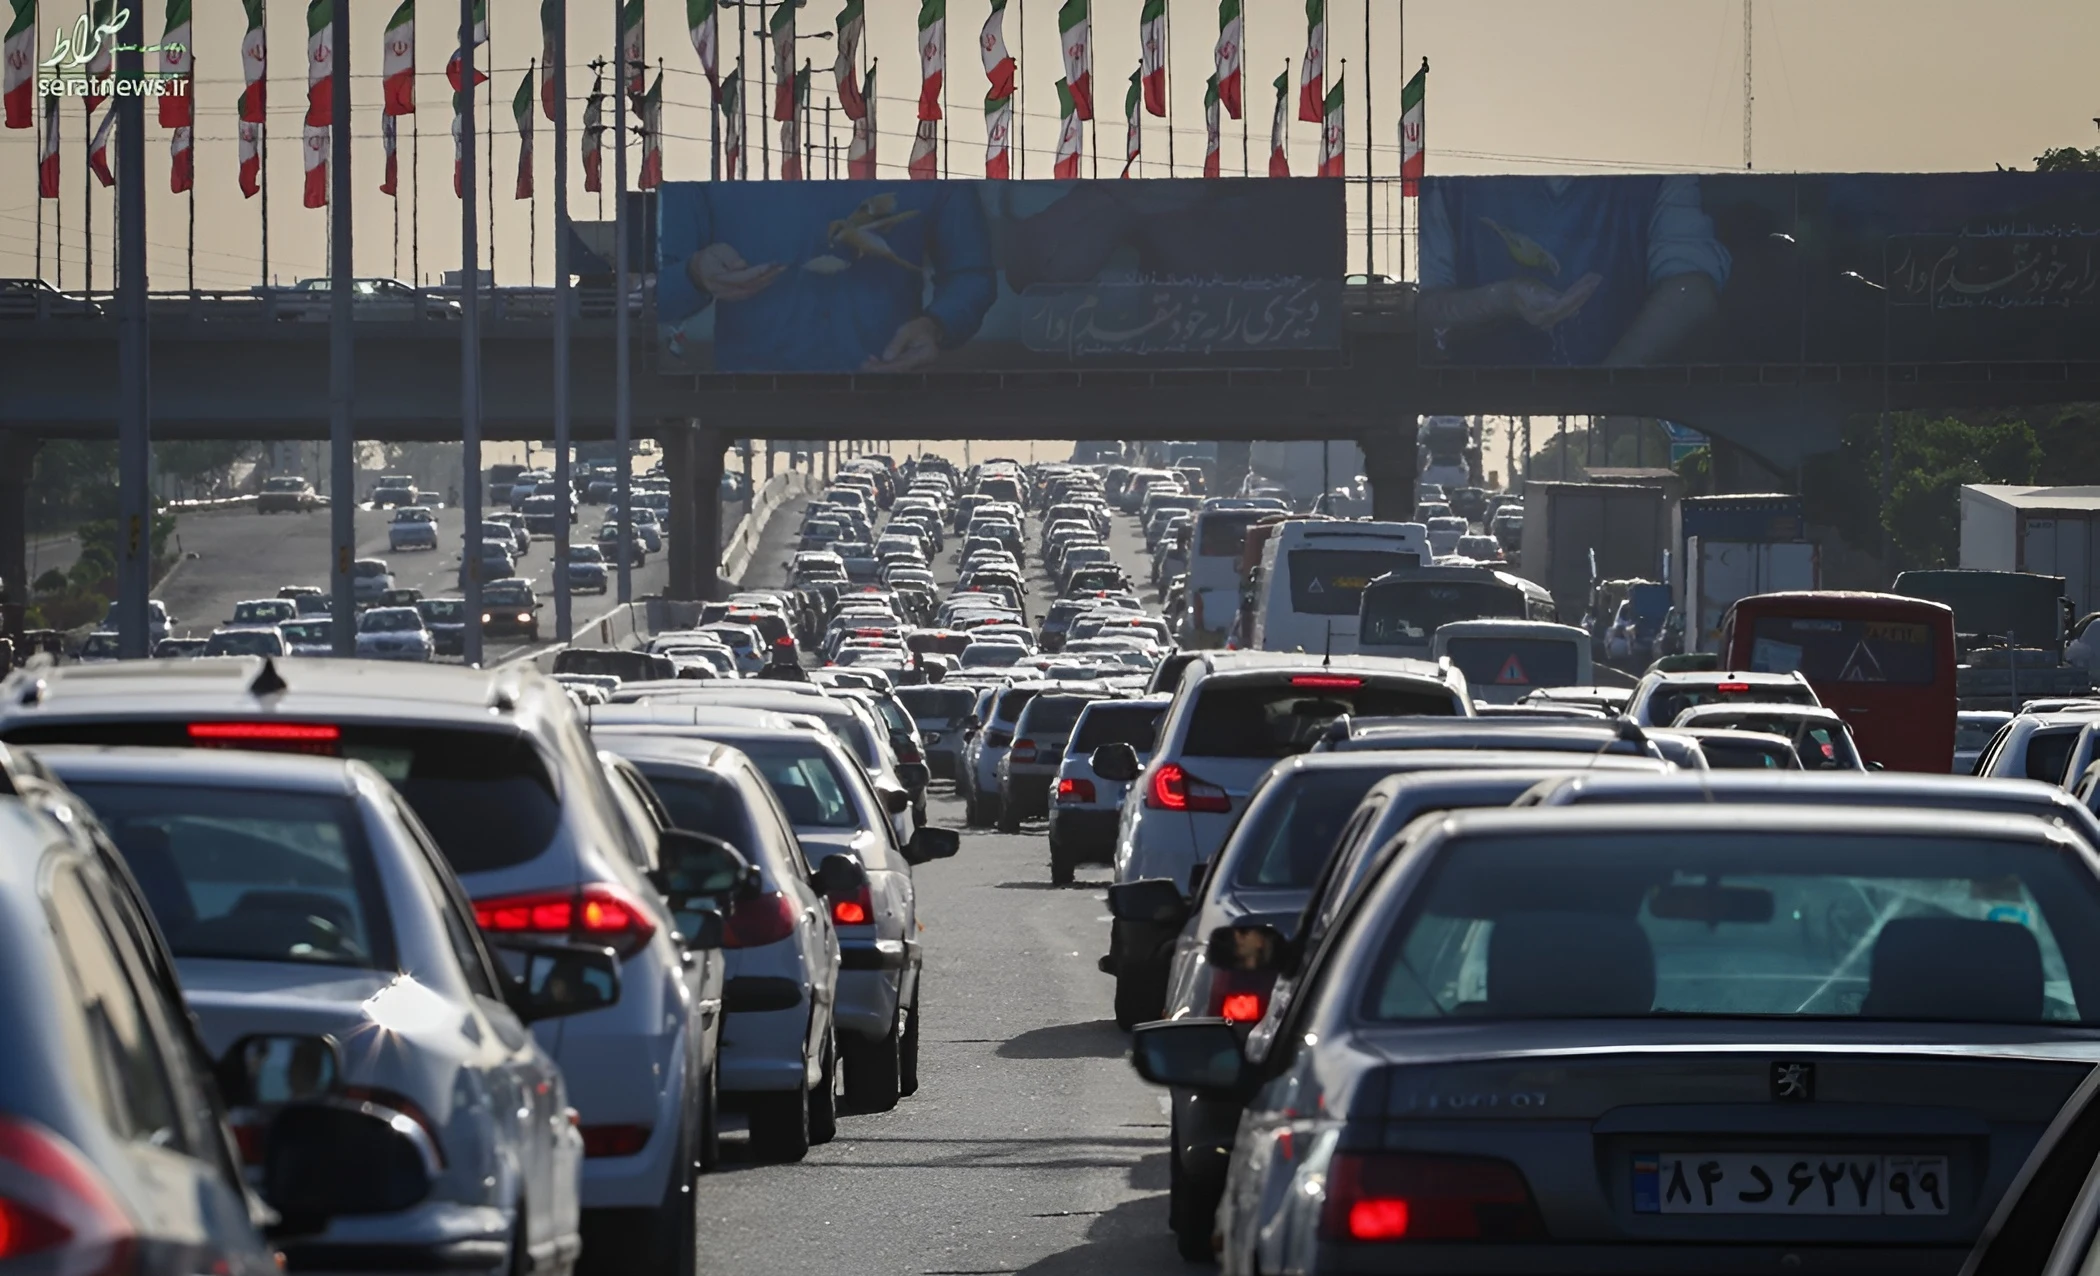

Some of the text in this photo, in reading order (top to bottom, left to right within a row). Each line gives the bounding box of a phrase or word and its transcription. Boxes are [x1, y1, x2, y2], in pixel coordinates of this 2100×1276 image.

[1031, 301, 1065, 342] دار
[1167, 294, 1208, 342] خود
[1221, 297, 1242, 342] را
[1243, 277, 1321, 345] دیگری
[1666, 1160, 1723, 1206] ۸۴
[1738, 1164, 1774, 1203] د
[1787, 1161, 1877, 1207] ۶۲۷
[1888, 1171, 1946, 1210] ۹۹
